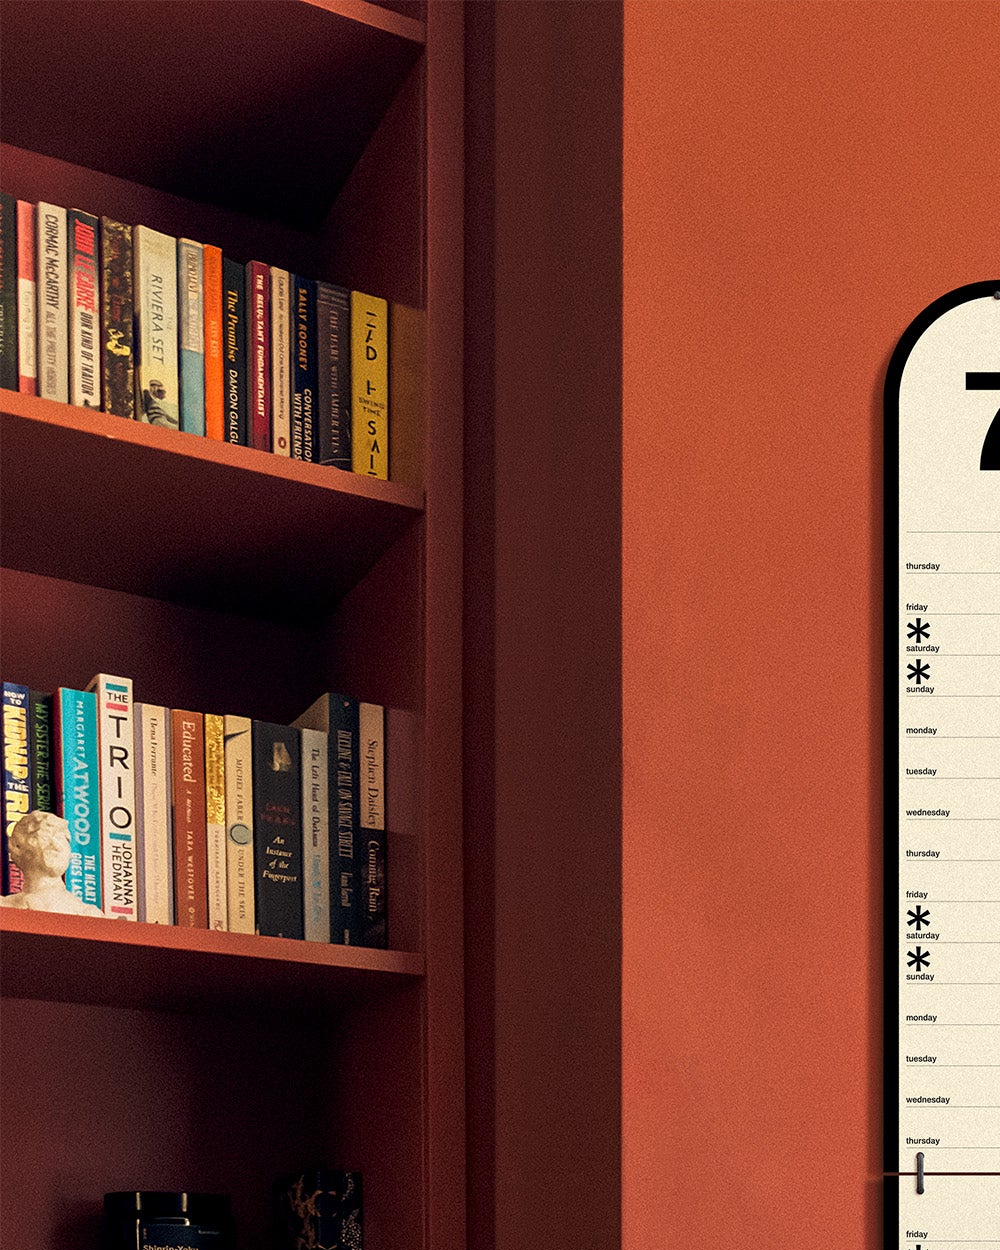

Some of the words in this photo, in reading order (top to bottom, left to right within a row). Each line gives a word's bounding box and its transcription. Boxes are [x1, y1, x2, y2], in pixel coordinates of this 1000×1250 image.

[45, 214, 59, 257] CORMAC
[74, 219, 95, 255] JOHN
[74, 254, 95, 269] LE
[45, 257, 59, 310] McCARTHY
[256, 274, 264, 289] THE
[151, 274, 164, 332] RIVIERA
[227, 289, 239, 311] The
[298, 288, 307, 321] SALLY
[80, 312, 93, 328] OUR
[256, 294, 264, 342] RELUCTANT
[81, 330, 93, 349] KIND
[228, 313, 239, 362] Promise
[299, 325, 308, 371] ROONEY
[81, 351, 93, 361] OF
[152, 337, 164, 364] SET
[81, 362, 94, 396] TRAITOR
[229, 369, 239, 410] DAMON
[257, 345, 265, 417] FUNDAMENTALIST
[294, 393, 302, 418] WITH
[229, 412, 239, 445] GALGU
[303, 388, 312, 462] CONVERSATIO
[294, 420, 302, 460] FRIENDS
[905, 562, 941, 571] thursday
[906, 603, 928, 612] friday
[906, 644, 940, 653] saturday
[3, 691, 26, 700] HOW
[107, 691, 129, 703] THE
[906, 685, 935, 694] sunday
[10, 698, 22, 706] TO
[34, 703, 48, 720] MY
[75, 700, 86, 758] MARGARET
[149, 717, 157, 740] Elena
[905, 726, 938, 735] monday
[3, 704, 29, 780] KIDNAP
[181, 720, 197, 783] Educated
[150, 741, 158, 777] Ferrante
[312, 748, 320, 761] The
[366, 739, 379, 783] Stephen
[36, 761, 49, 779] THE
[108, 714, 132, 829] TRIO
[235, 759, 243, 790] MICHEL
[906, 767, 937, 776] tuesday
[7, 782, 28, 792] THE
[37, 783, 50, 812] SERIA
[338, 788, 353, 800] ON
[72, 757, 90, 846] ATWOOD
[236, 794, 244, 821] FABER
[366, 787, 380, 826] Daisley
[905, 808, 951, 817] wednesday
[186, 830, 194, 851] TARA
[272, 836, 285, 845] An
[338, 831, 354, 859] STREET
[70, 852, 82, 876] GOES
[84, 855, 95, 871] THE
[237, 849, 245, 878] UNDER
[367, 839, 380, 884] Coming
[905, 849, 941, 858] thursday
[111, 846, 123, 901] HEDMAN
[122, 843, 133, 906] JOHANNA
[187, 855, 195, 900] WESTOVER
[71, 878, 83, 899] LAS
[84, 873, 96, 902] HEART
[368, 887, 380, 912] Rain
[905, 890, 929, 899] friday
[906, 931, 940, 940] saturday
[906, 973, 935, 981] sunday
[906, 1014, 938, 1022] monday
[905, 1055, 937, 1063] tuesday
[905, 1095, 951, 1104] wednesday
[906, 1136, 941, 1145] thursday
[906, 1230, 928, 1239] friday
